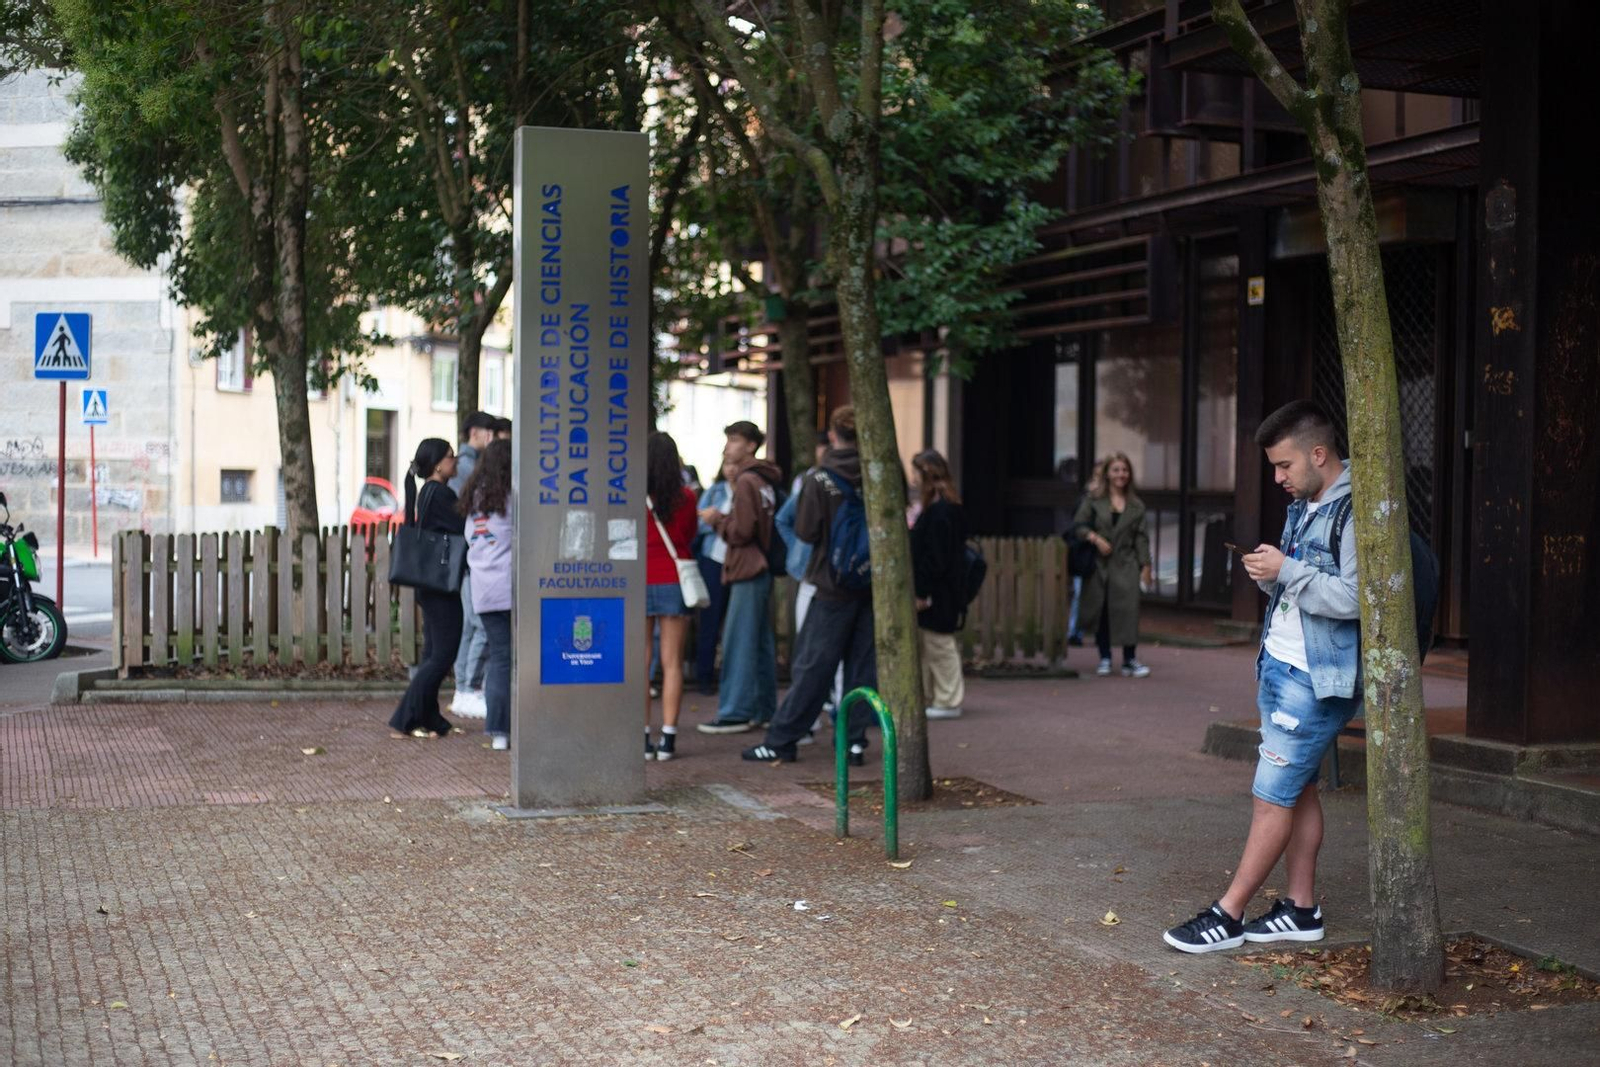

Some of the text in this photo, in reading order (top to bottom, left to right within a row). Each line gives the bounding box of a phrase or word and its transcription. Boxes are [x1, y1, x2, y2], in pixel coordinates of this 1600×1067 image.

[539, 183, 563, 506] FACULTADE DE CIENCIAS
[563, 303, 591, 506] DA EDUCACIÓN
[607, 184, 631, 506] FACULTADE DE HISTORIA
[539, 577, 628, 589] FACULTADES
[553, 562, 614, 574] EDIFICIO
